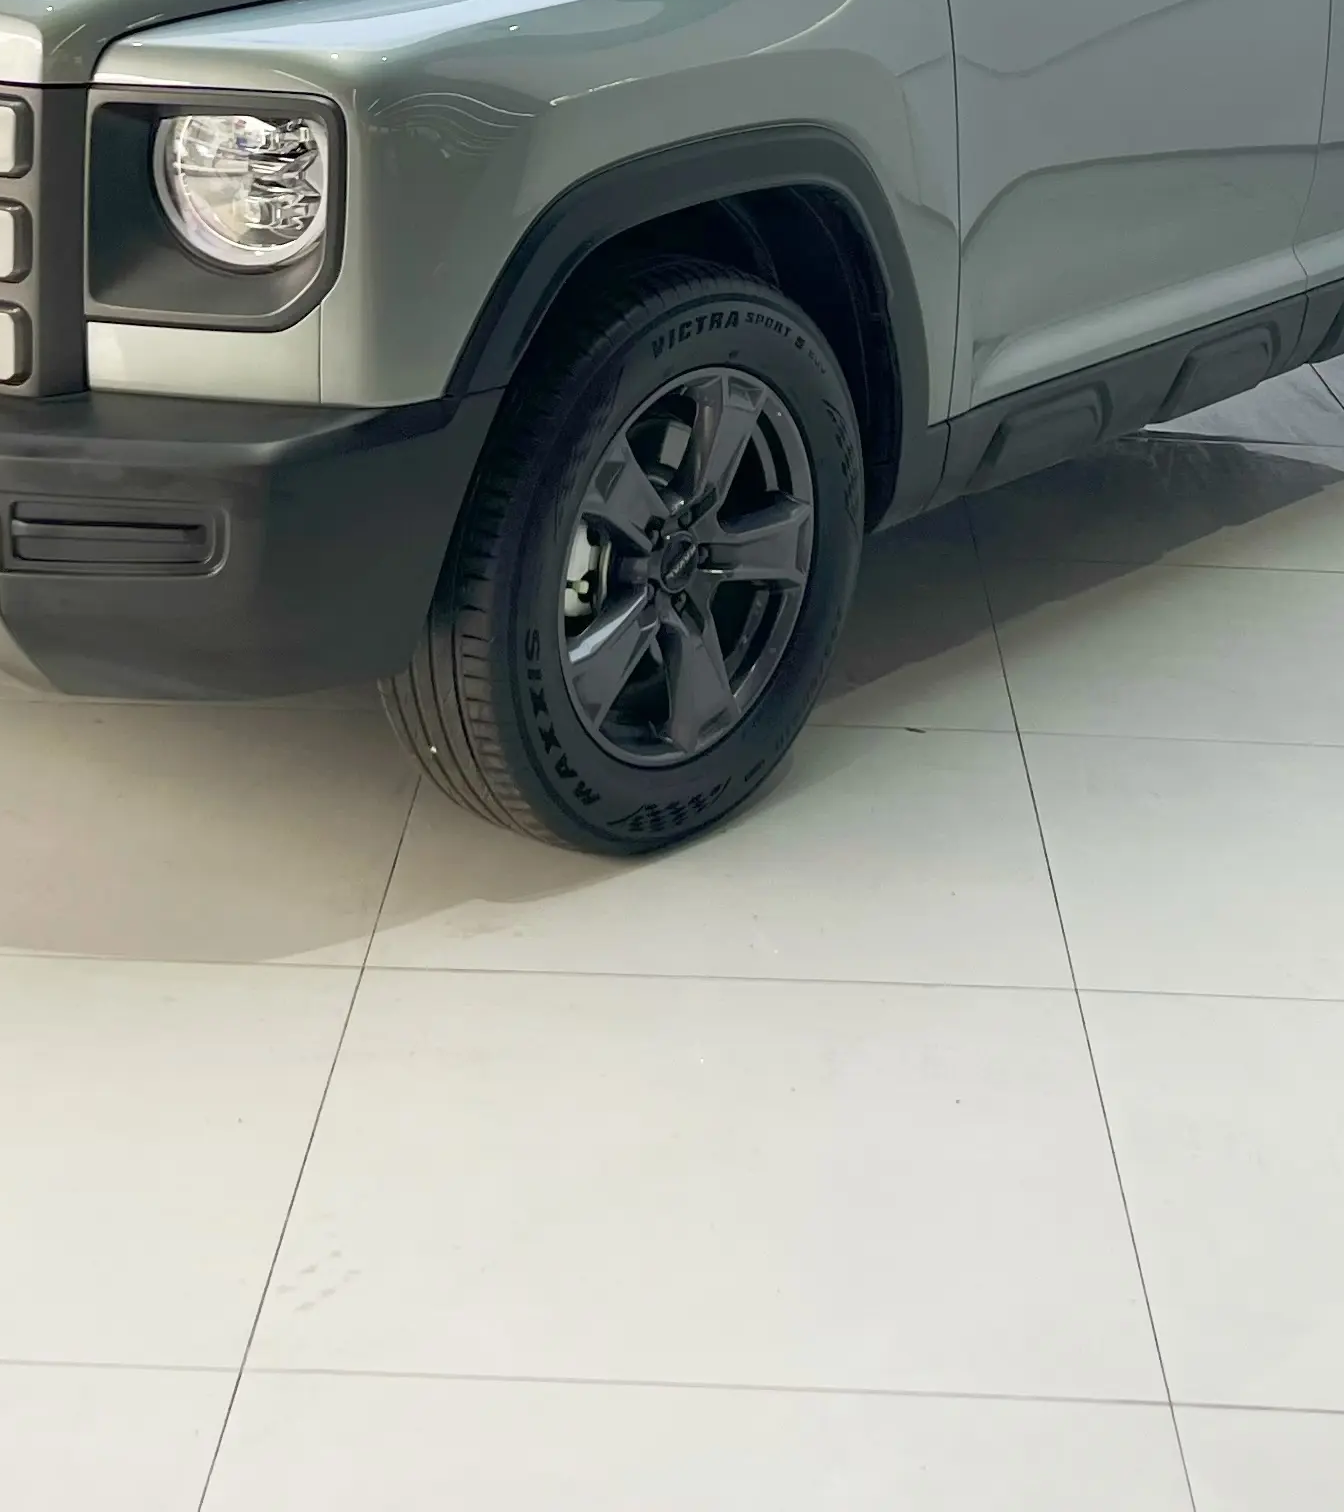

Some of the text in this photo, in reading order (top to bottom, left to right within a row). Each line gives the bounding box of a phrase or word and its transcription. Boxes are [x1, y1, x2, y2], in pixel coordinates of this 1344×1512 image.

[651, 310, 739, 359] VICTRA
[744, 312, 793, 337] SPORT
[525, 628, 601, 806] MAXXIS
